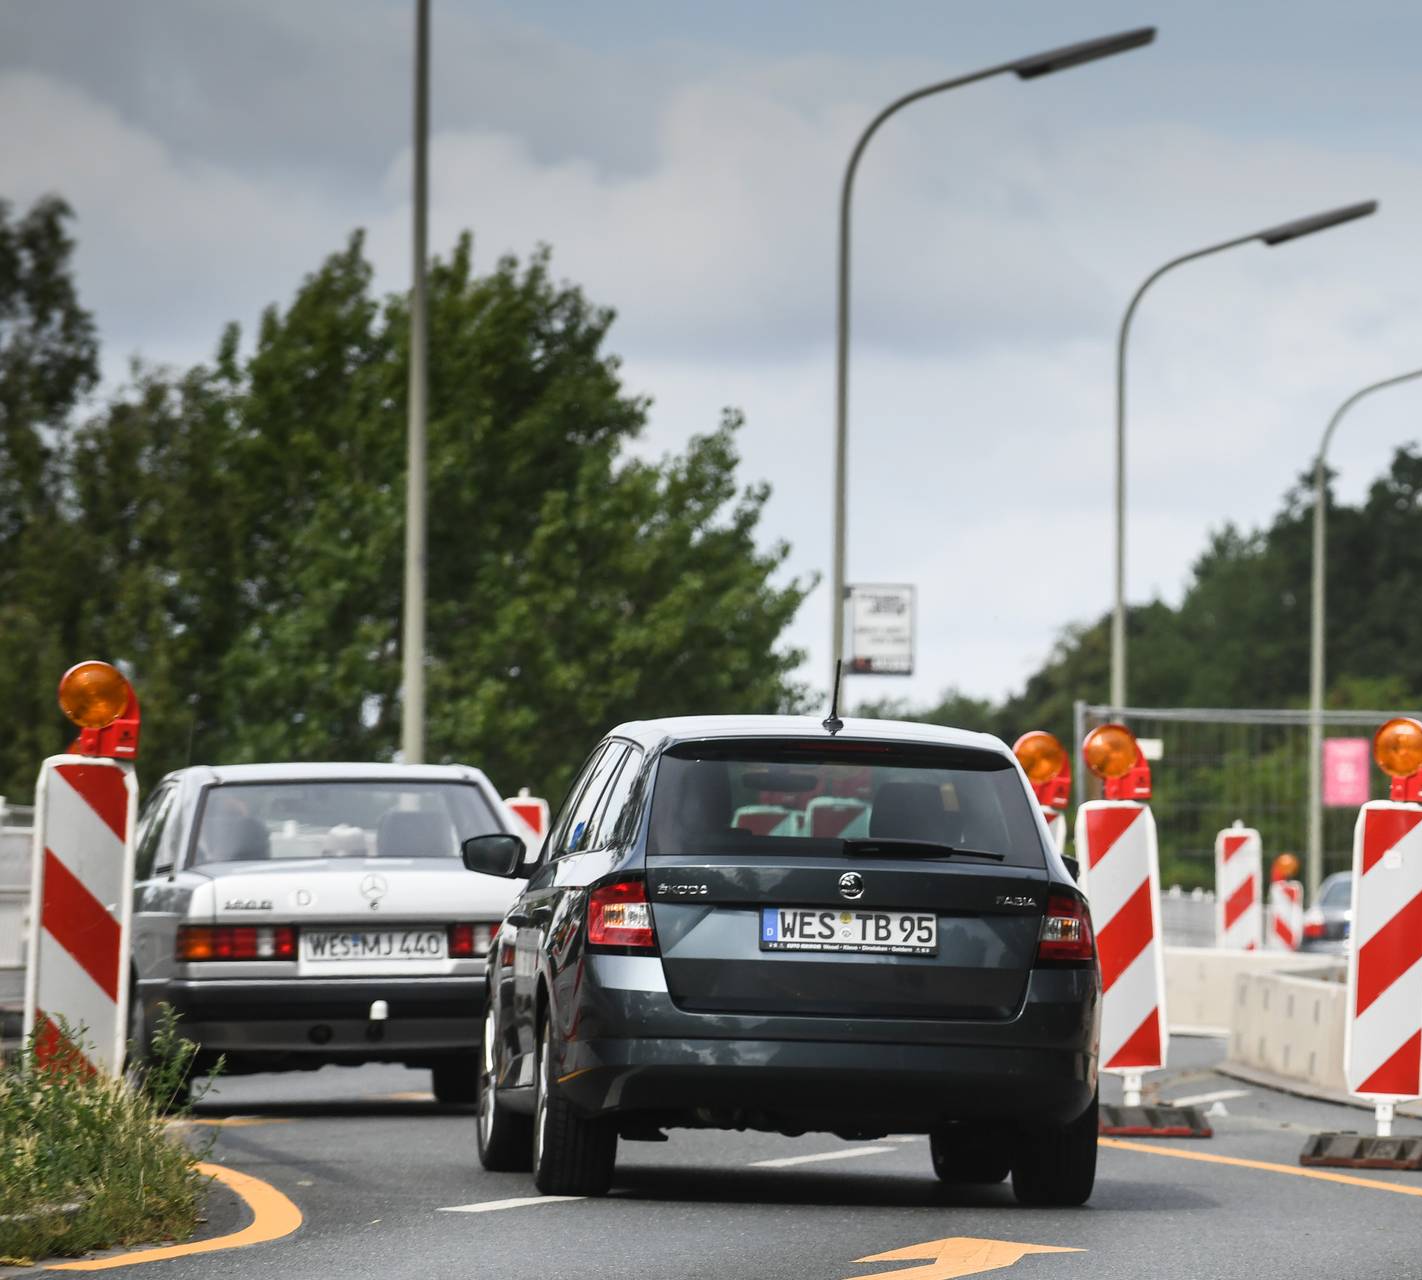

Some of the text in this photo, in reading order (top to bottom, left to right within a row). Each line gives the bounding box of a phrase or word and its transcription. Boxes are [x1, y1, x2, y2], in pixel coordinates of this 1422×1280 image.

[766, 911, 934, 943] D WES TB 95
[308, 932, 441, 957] WES MJ 440
